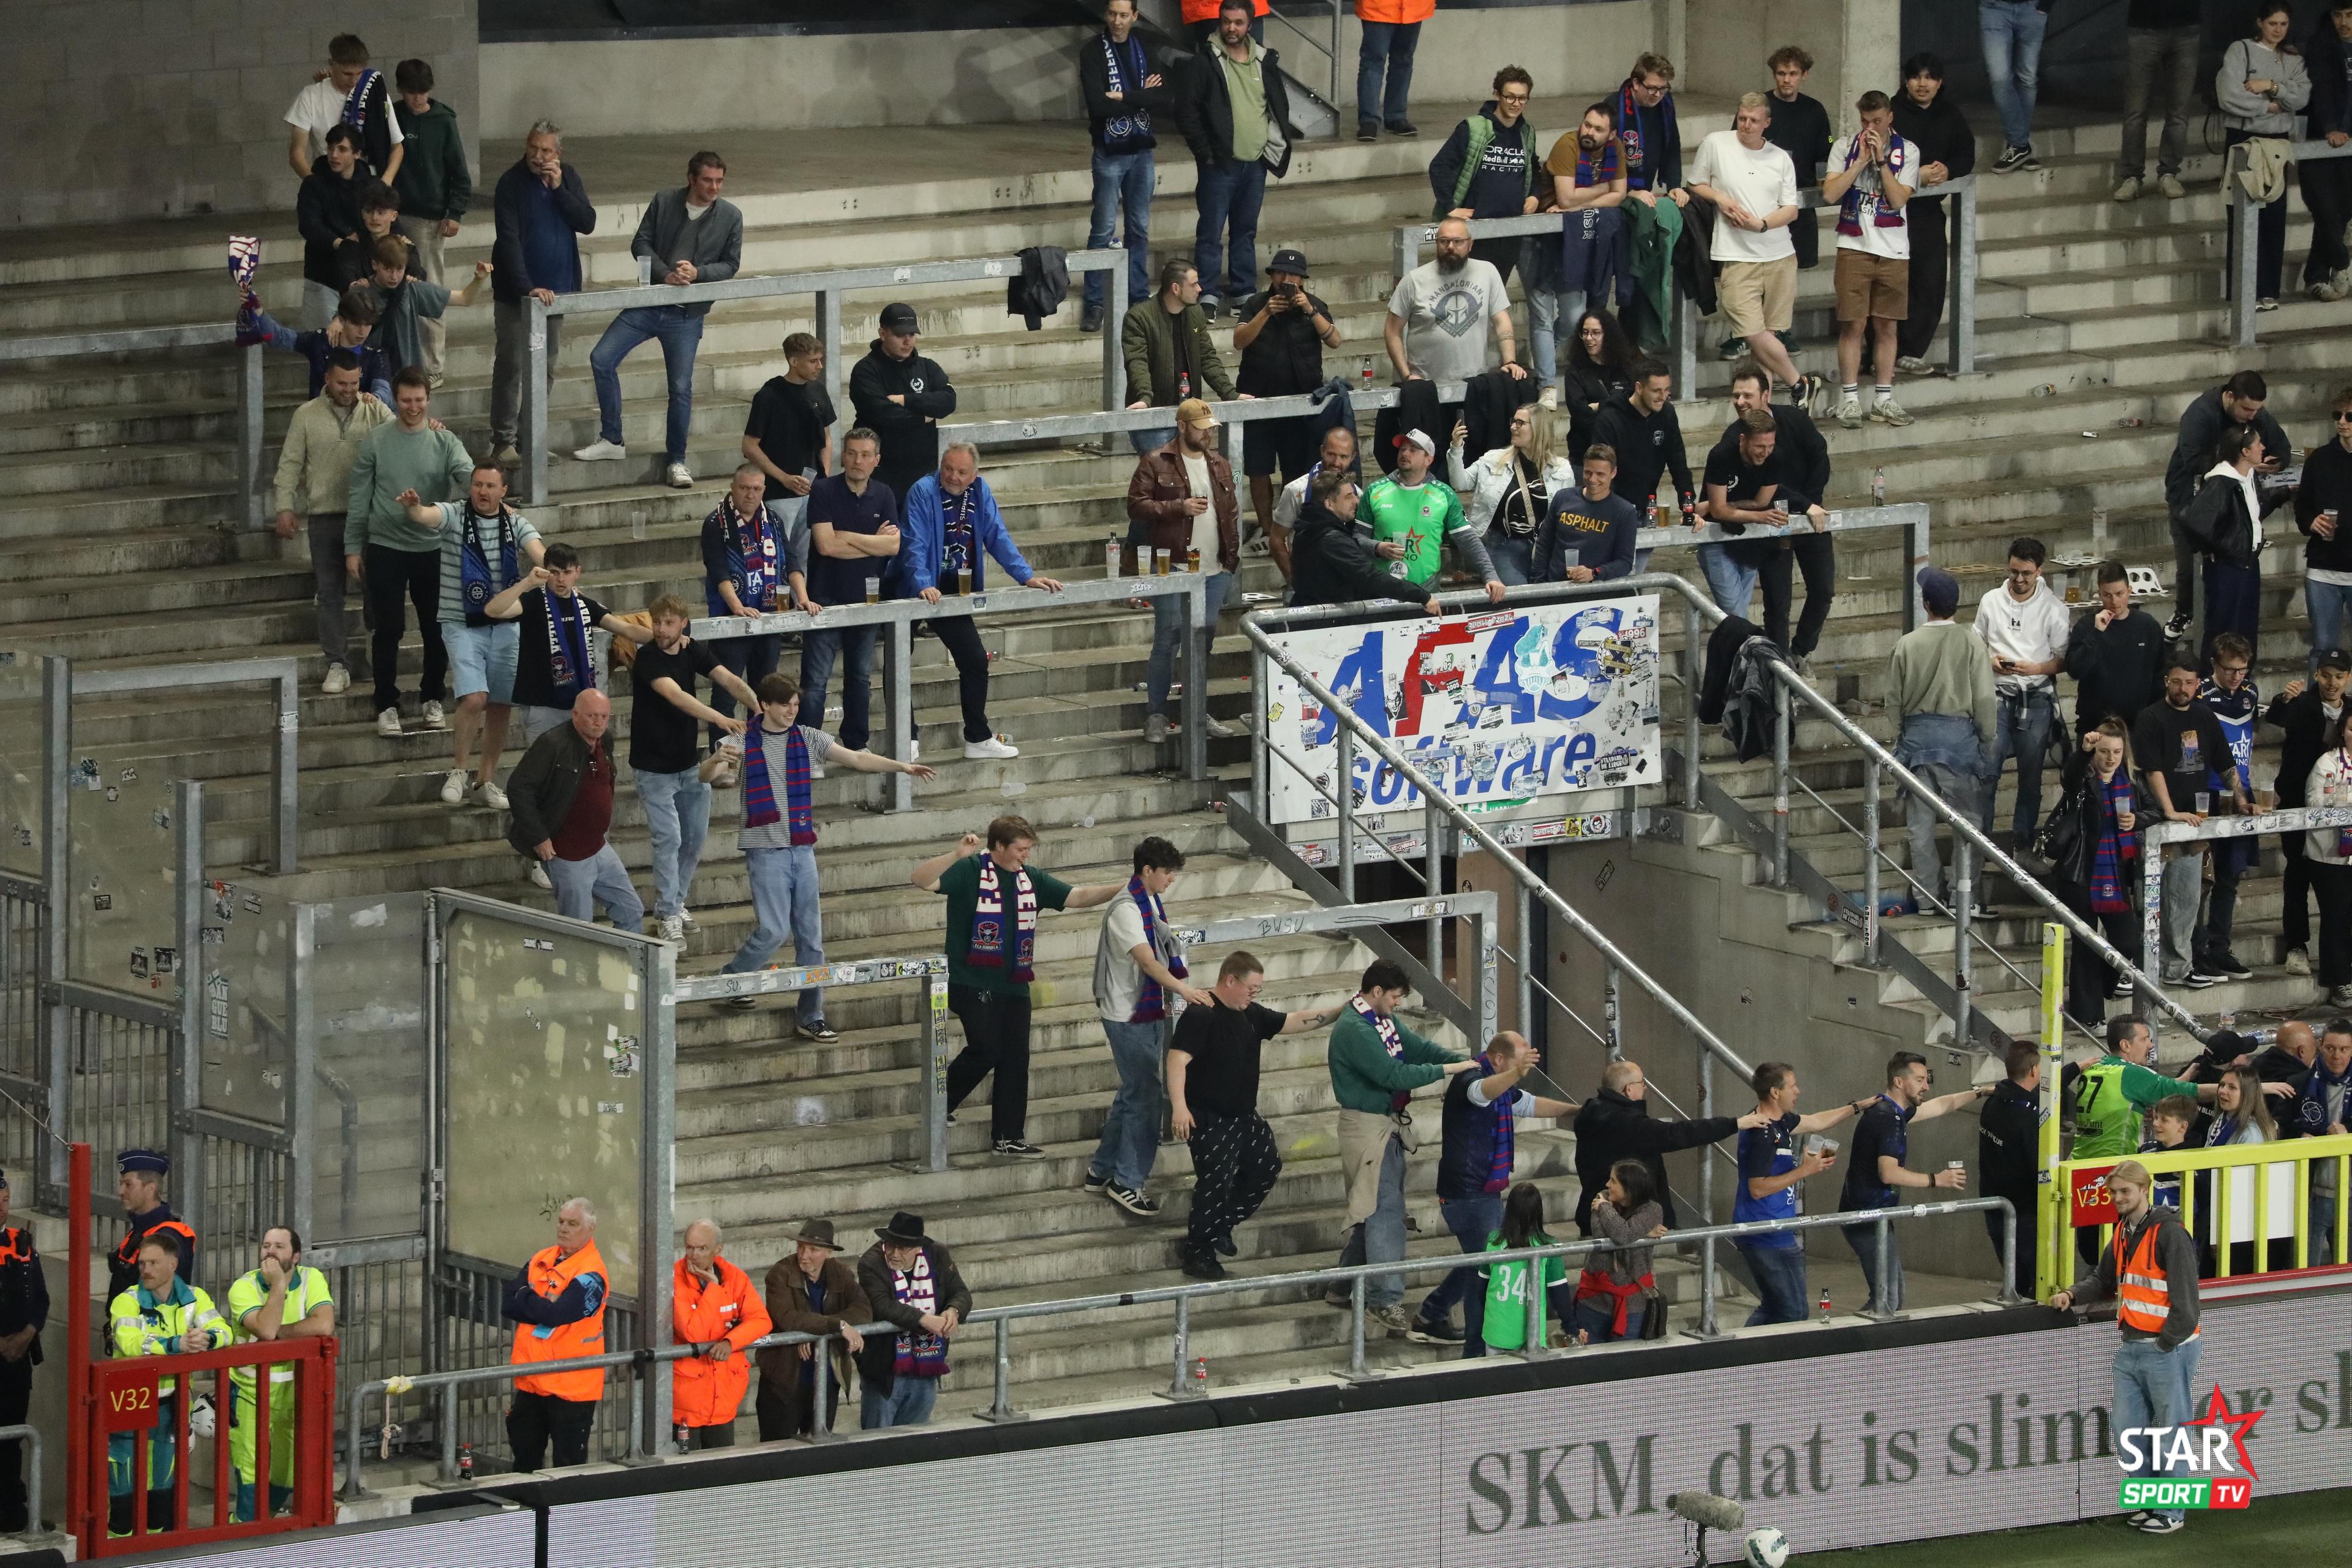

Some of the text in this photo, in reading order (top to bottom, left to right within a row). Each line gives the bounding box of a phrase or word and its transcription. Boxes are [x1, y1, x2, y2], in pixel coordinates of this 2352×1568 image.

[1485, 145, 1525, 156] ORACLE
[1429, 280, 1483, 303] MANDALORIAN
[1559, 511, 1610, 533] ASPHALT
[1317, 607, 1624, 745] AFAS
[1338, 732, 1597, 806] software
[2076, 1075, 2104, 1114] 27
[2202, 1107, 2215, 1117] BLUE
[2077, 1186, 2111, 1208] V33
[1496, 1264, 1534, 1305] 34
[110, 1387, 150, 1412] V32
[1466, 1433, 1659, 1536] SKM
[1709, 1423, 1834, 1503] dat
[1860, 1411, 1918, 1488] is
